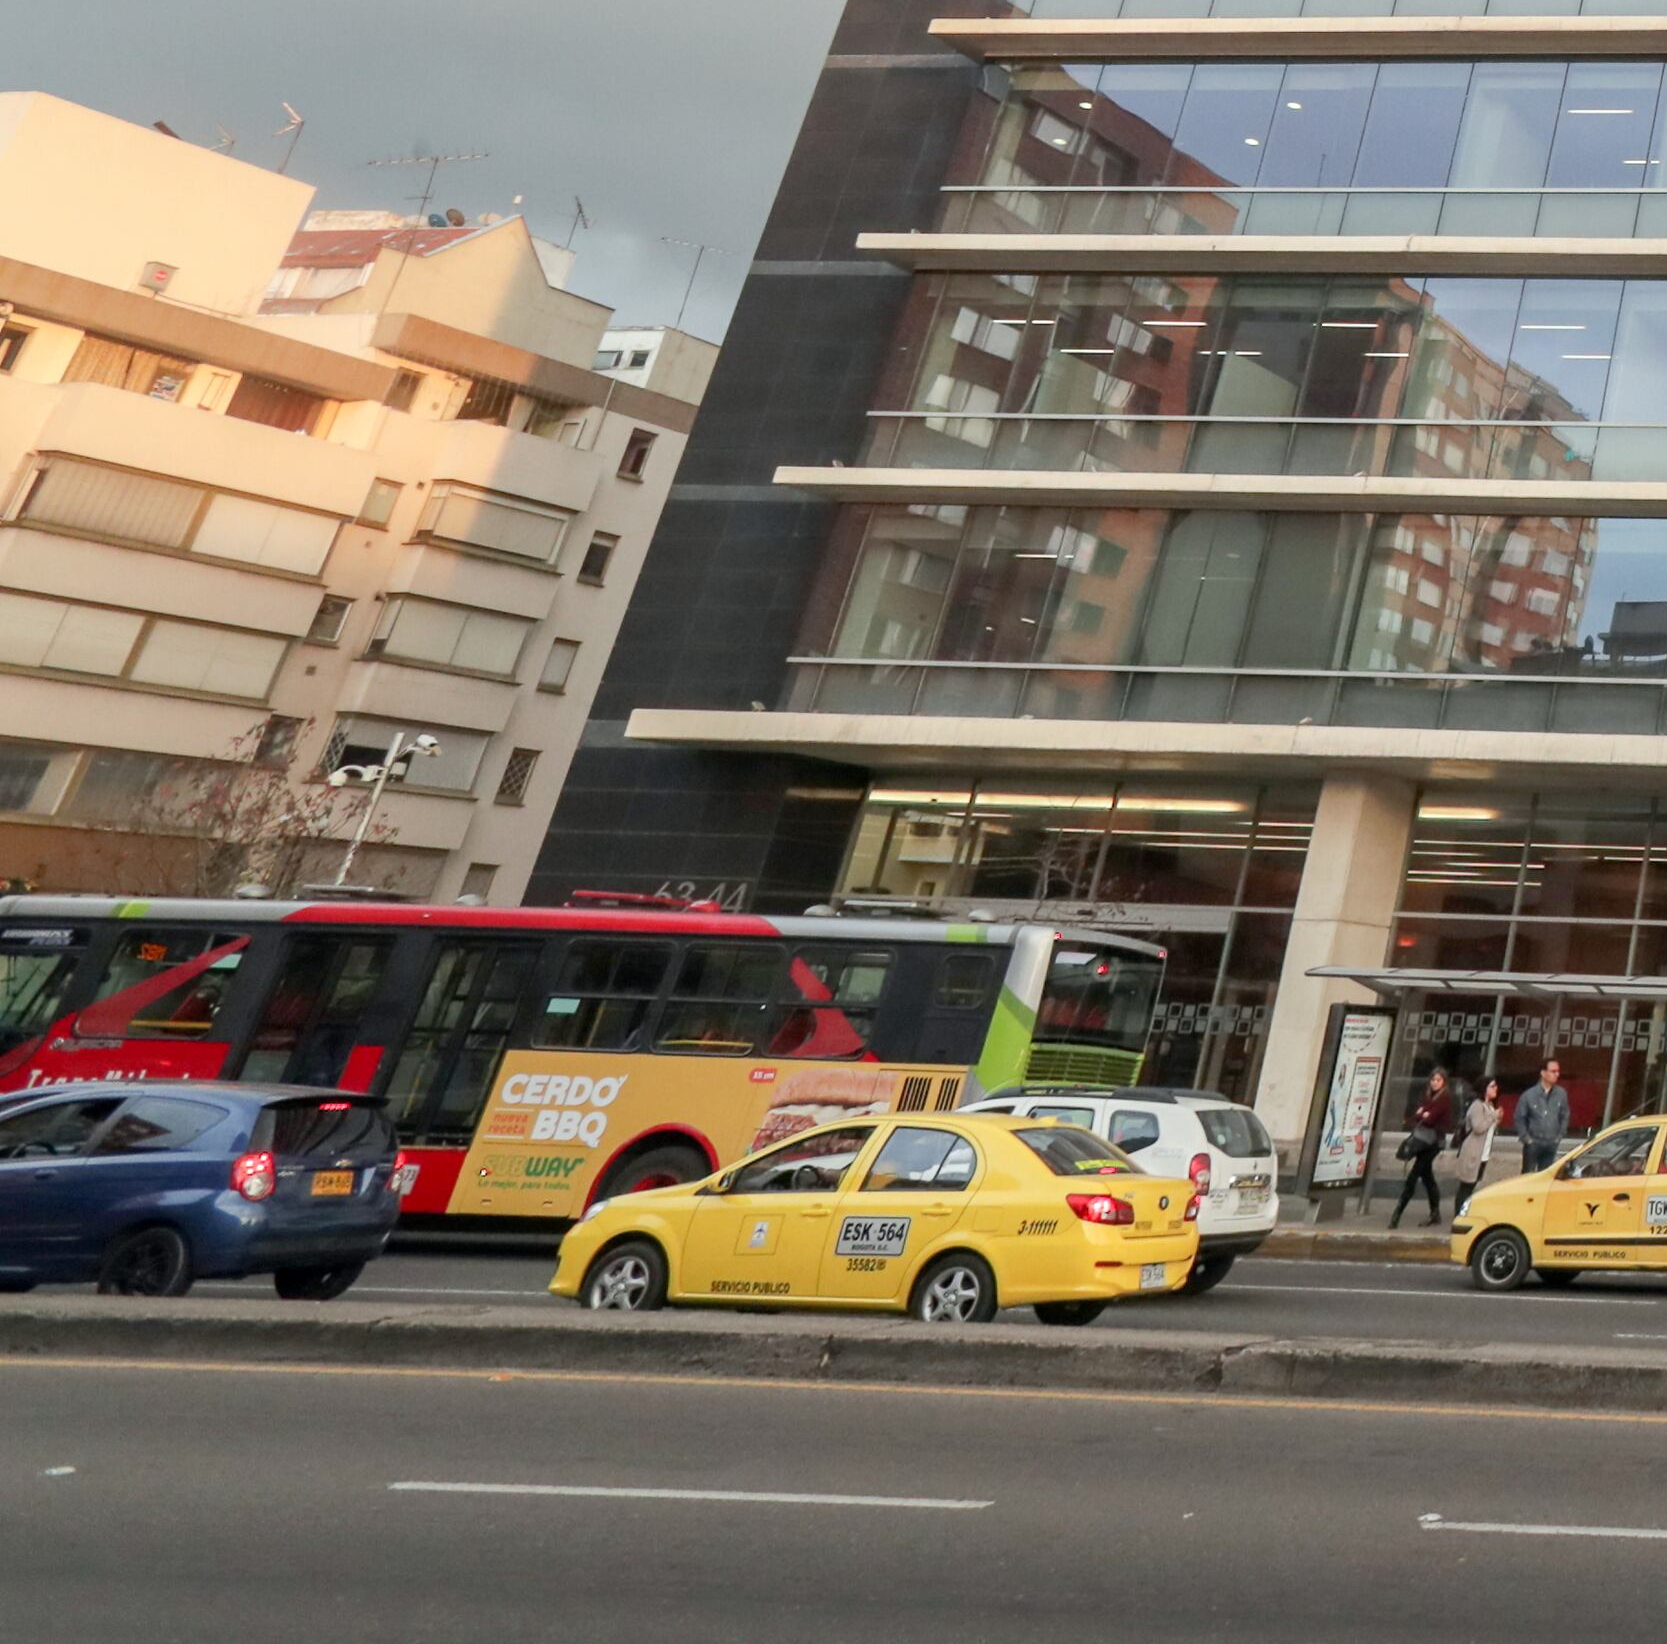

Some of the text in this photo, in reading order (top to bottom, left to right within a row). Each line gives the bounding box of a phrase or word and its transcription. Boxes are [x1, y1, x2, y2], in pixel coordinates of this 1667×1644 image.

[502, 1073, 624, 1108] CERDO
[530, 1109, 608, 1148] BBQ
[481, 1155, 584, 1177] SUBWAY
[1554, 1249, 1589, 1259] SERVICIO
[846, 1258, 877, 1272] 35582
[711, 1280, 750, 1293] SERVICIO
